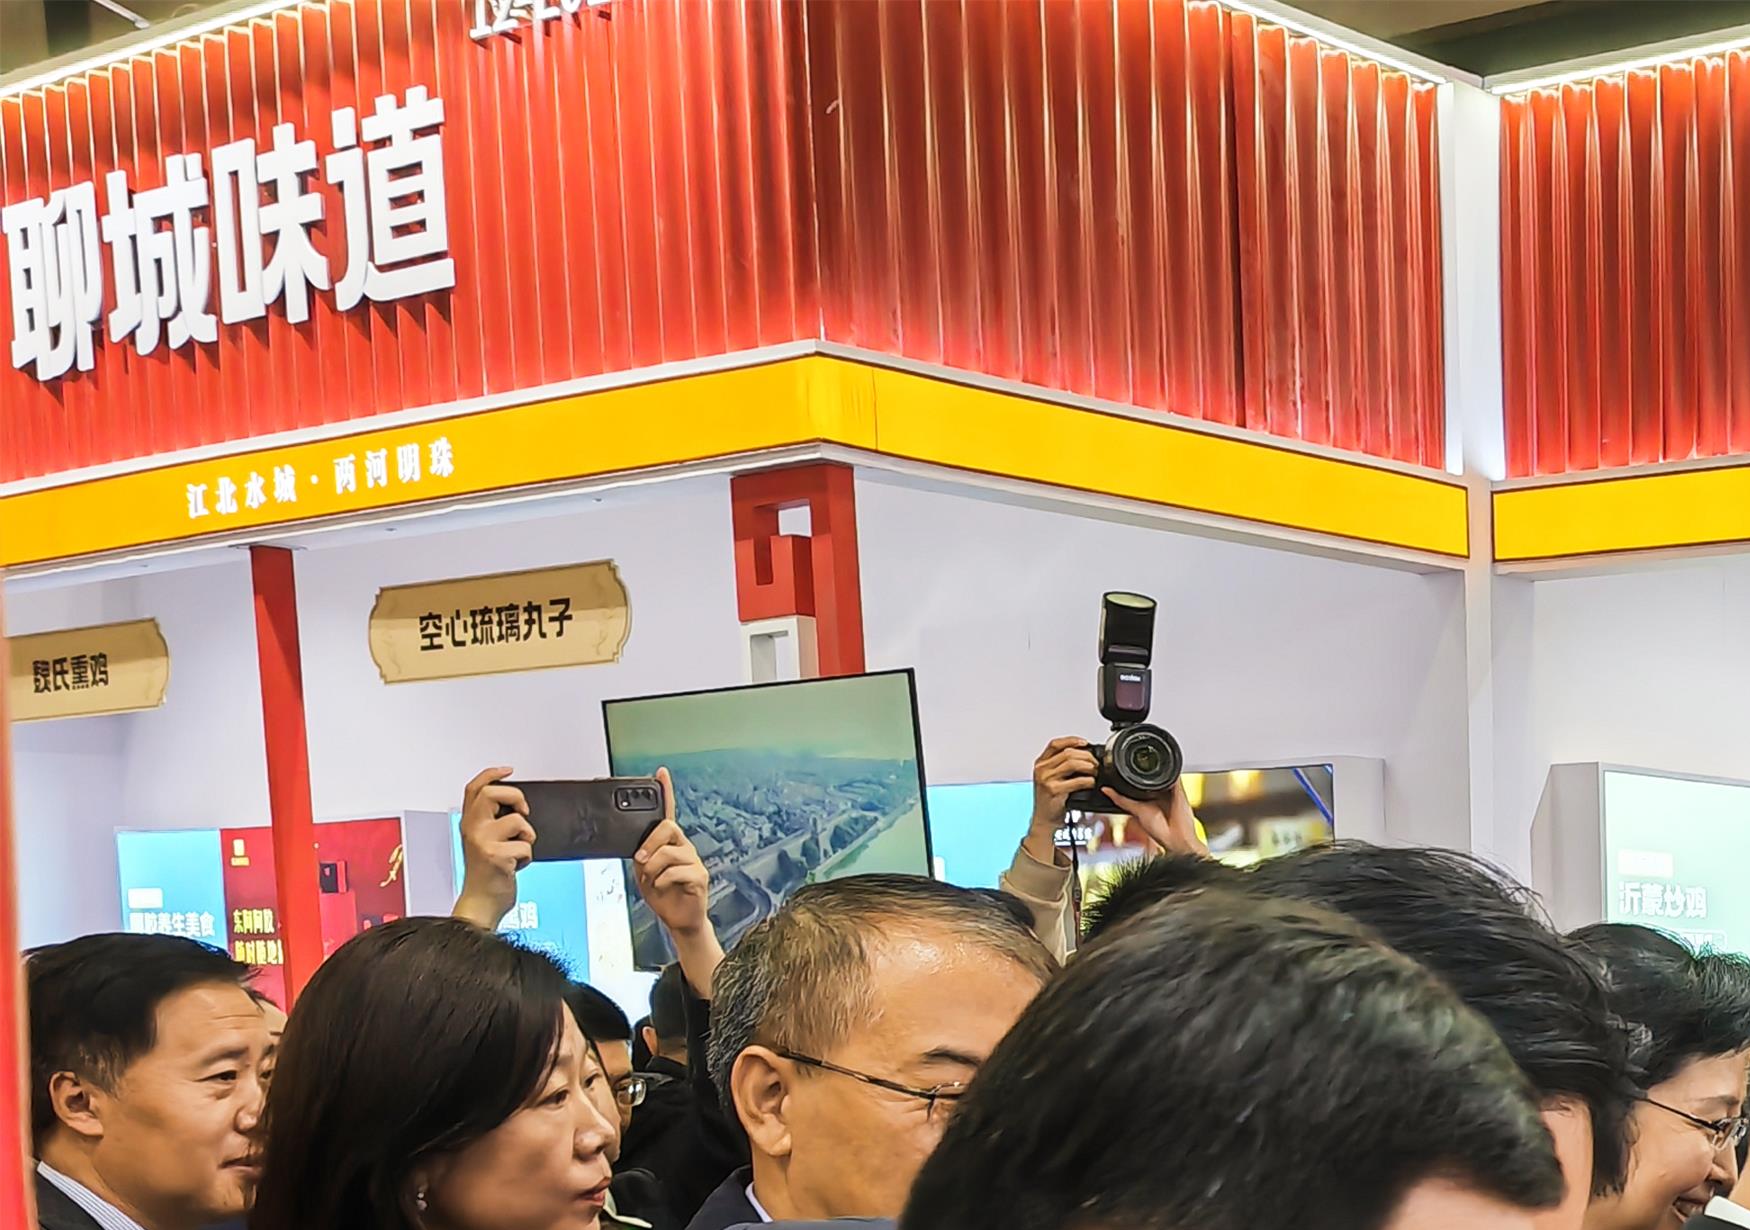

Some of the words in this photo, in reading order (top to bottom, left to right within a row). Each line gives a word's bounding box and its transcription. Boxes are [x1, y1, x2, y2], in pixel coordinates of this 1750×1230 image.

[3, 86, 455, 381] 聊城味道
[186, 436, 454, 519] 江北水城·两河明珠
[419, 597, 573, 651] 空心琉璃丸子
